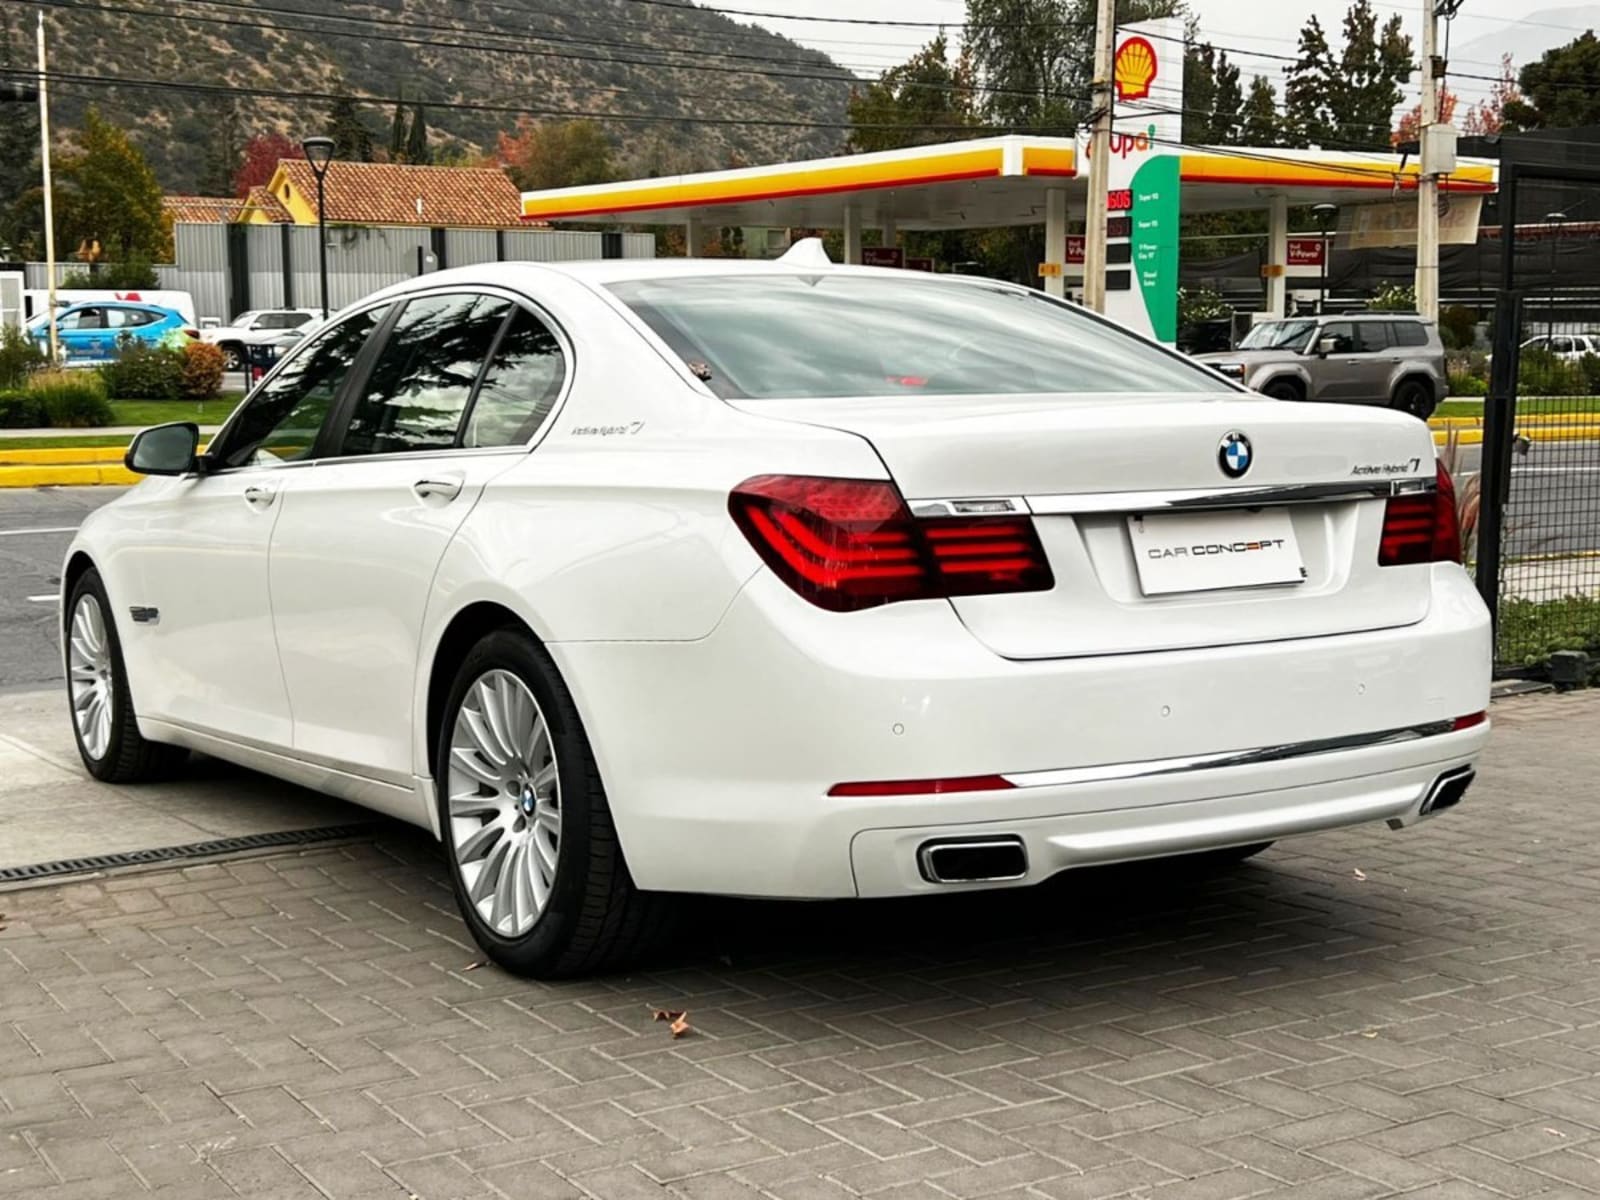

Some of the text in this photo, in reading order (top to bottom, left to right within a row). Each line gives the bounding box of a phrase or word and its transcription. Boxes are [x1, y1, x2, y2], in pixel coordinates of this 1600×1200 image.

[1409, 458, 1420, 472] 7
[1148, 539, 1285, 559] CAR CONCEPT
